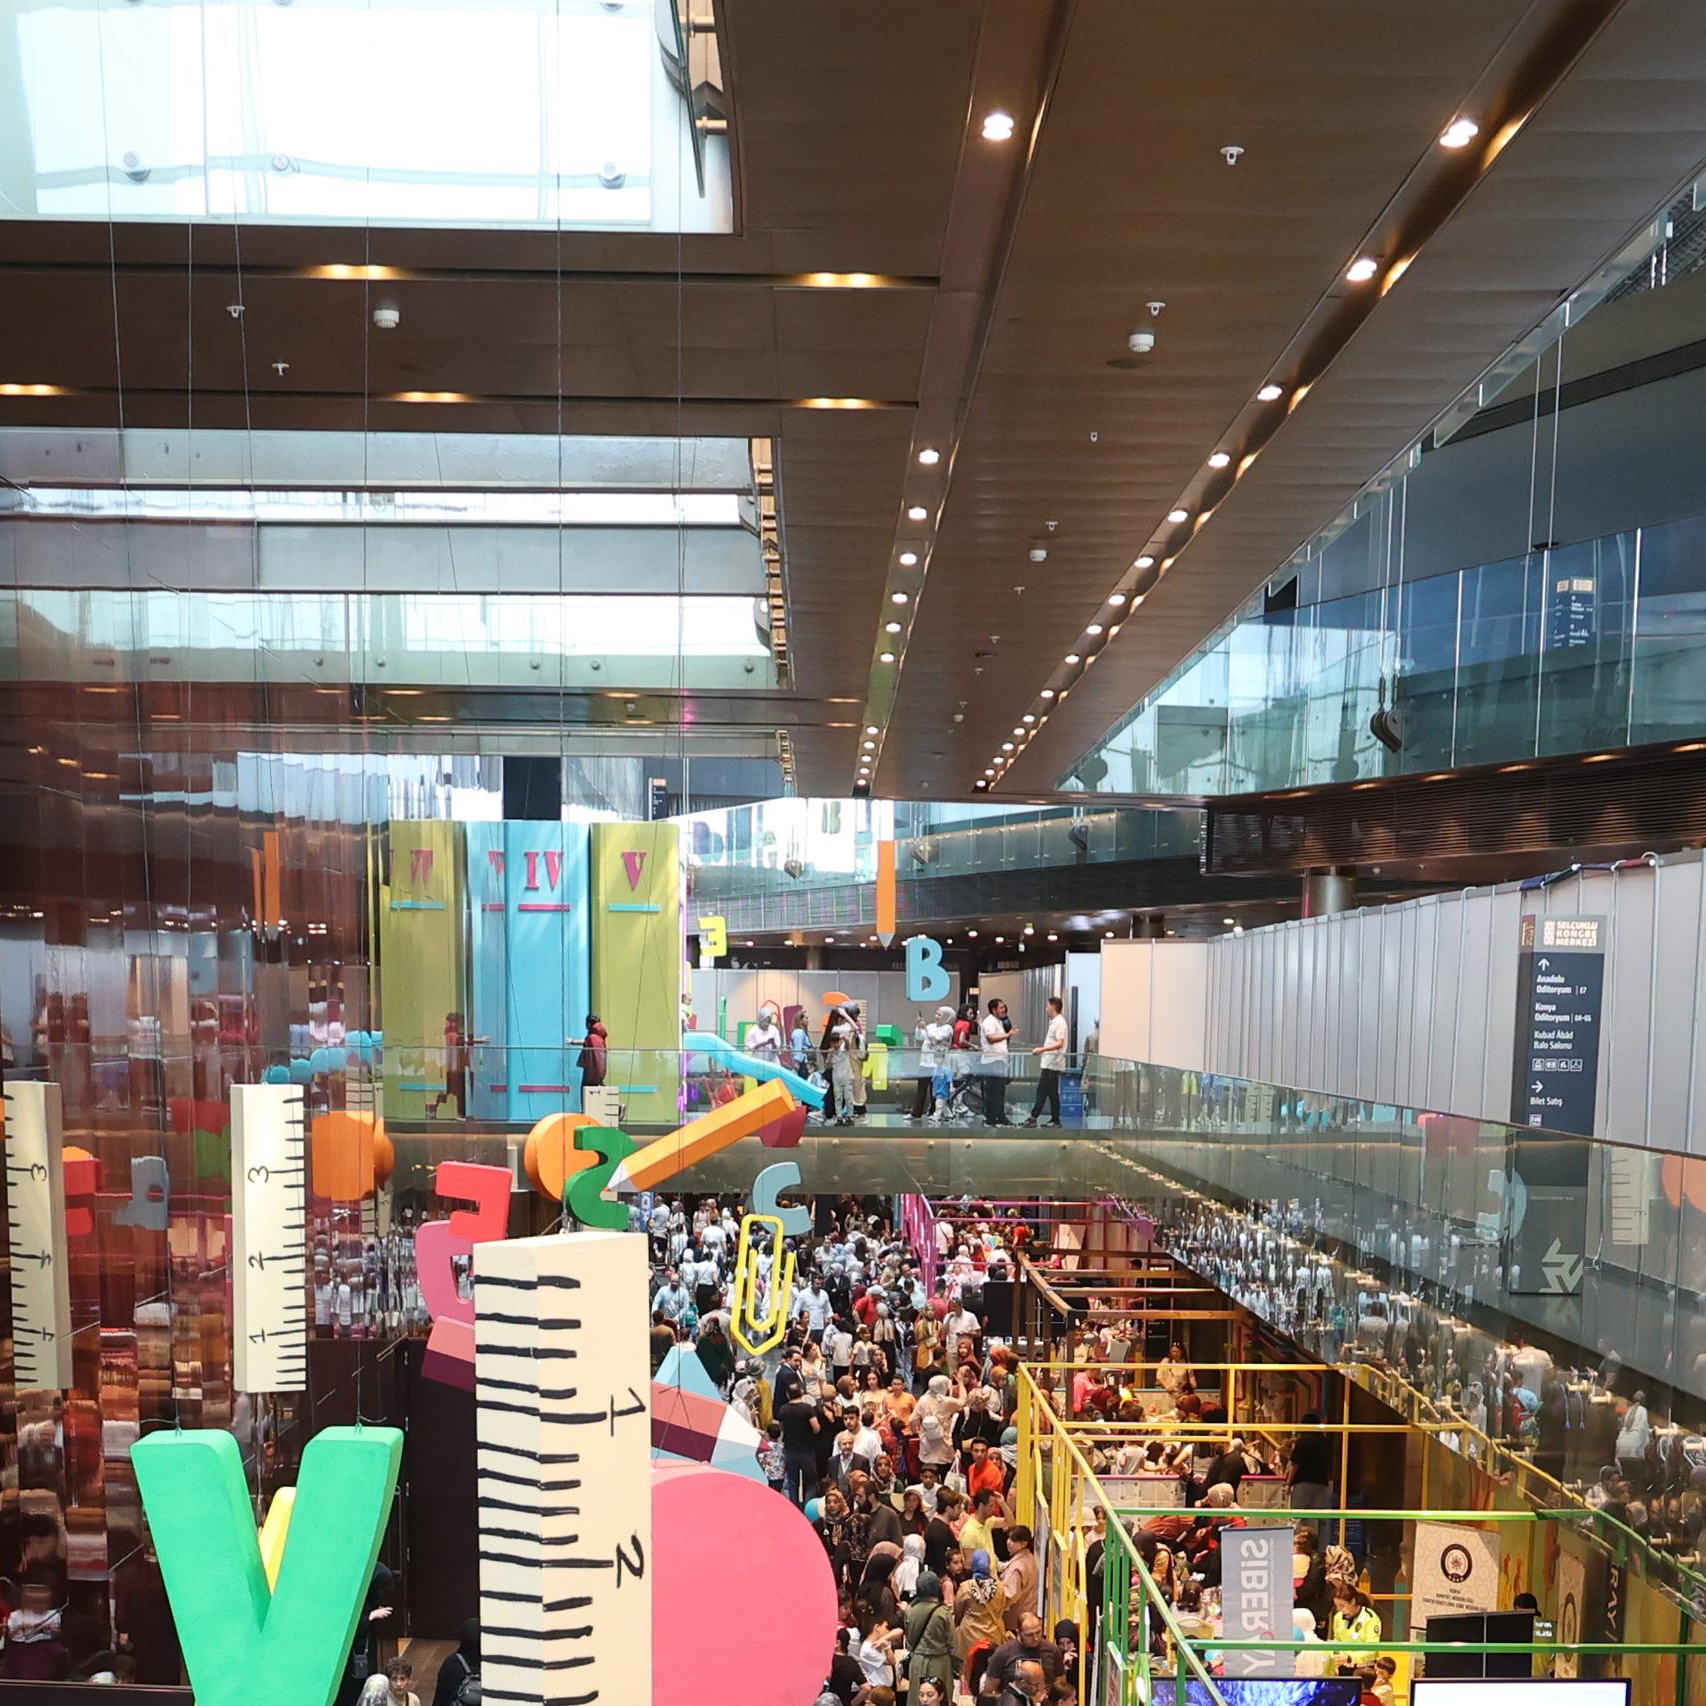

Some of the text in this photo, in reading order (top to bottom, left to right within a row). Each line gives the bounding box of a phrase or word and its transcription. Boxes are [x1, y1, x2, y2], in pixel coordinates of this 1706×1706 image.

[523, 851, 565, 890] IV
[621, 851, 648, 891] V
[1556, 929, 1597, 938] KONGRE
[905, 936, 950, 1001] B
[1536, 974, 1565, 984] Anadolu
[1536, 984, 1572, 996] Oditoryum
[1535, 1002, 1557, 1013] Konya
[1534, 1013, 1570, 1024] Oditoryum
[1549, 1041, 1573, 1050] Salonu
[1530, 1096, 1546, 1105] Bilet
